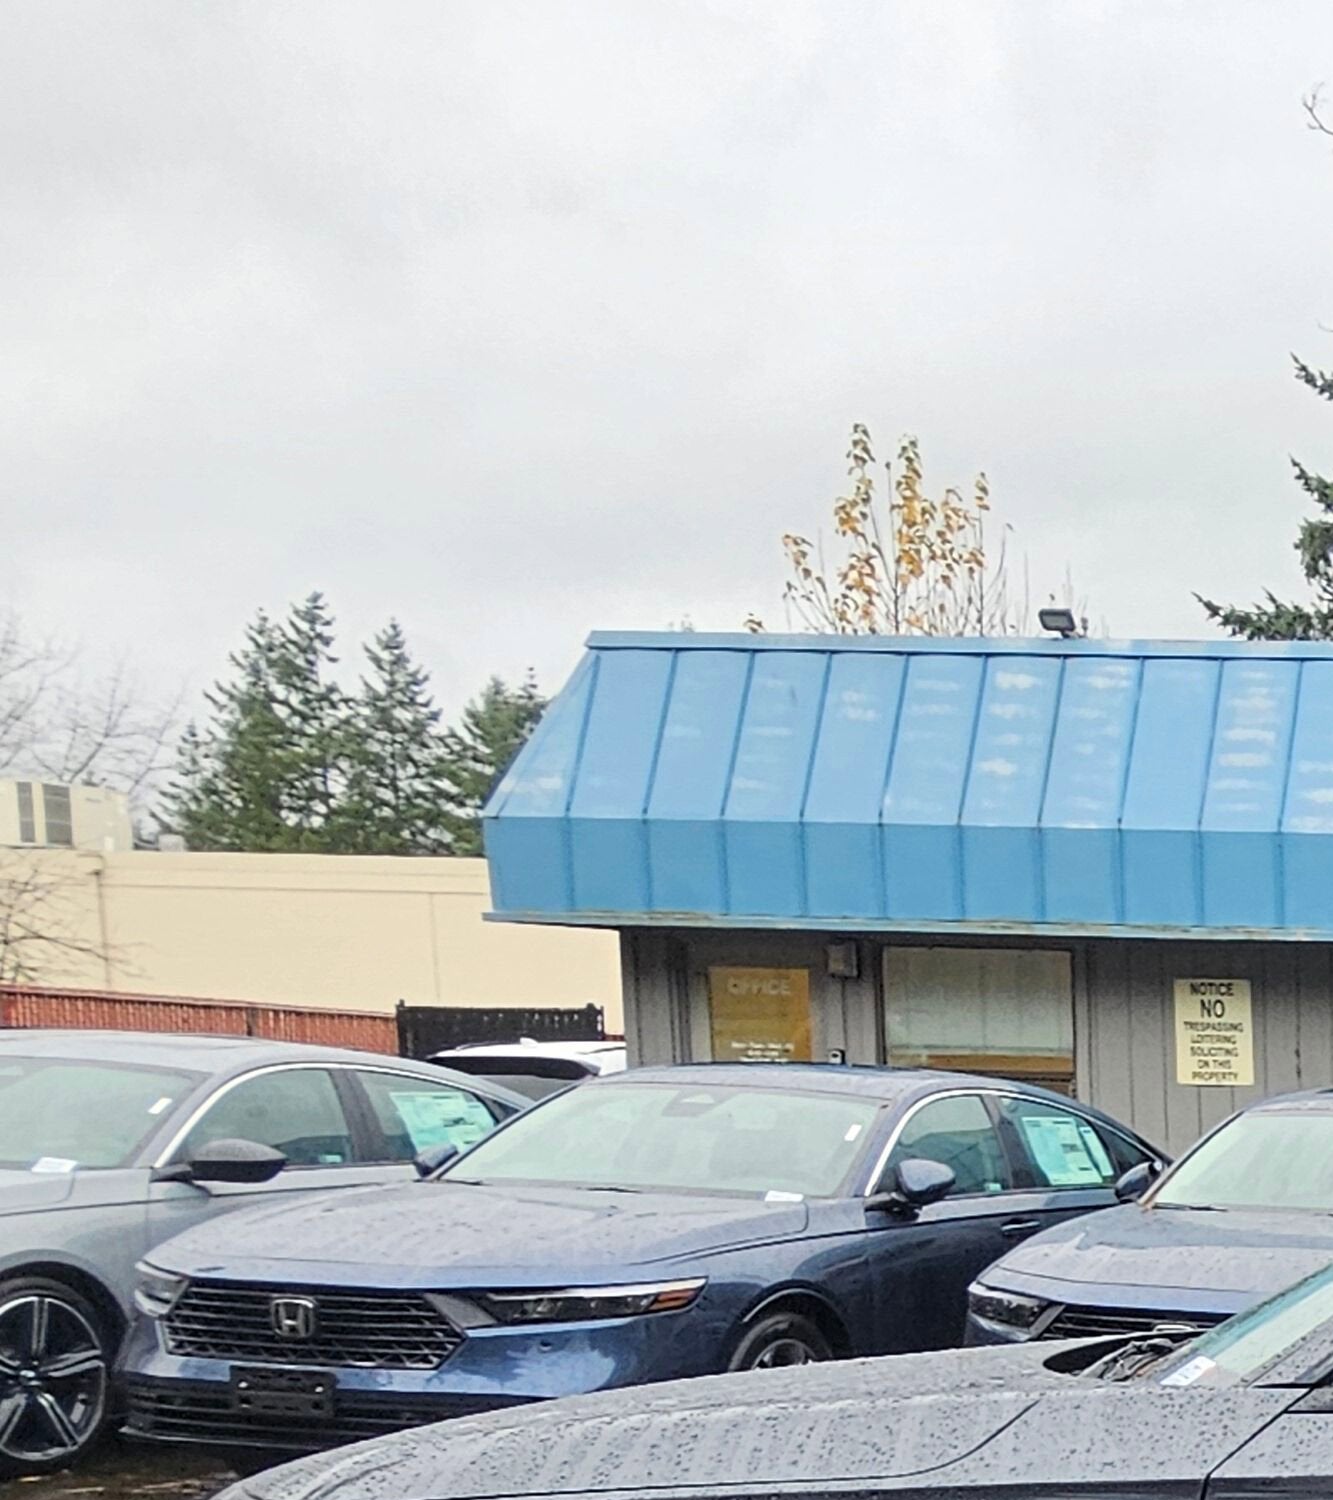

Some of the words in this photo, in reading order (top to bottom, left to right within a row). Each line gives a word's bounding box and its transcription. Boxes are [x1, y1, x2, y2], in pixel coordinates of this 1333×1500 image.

[1190, 982, 1234, 996] NOTICE
[1200, 999, 1225, 1018] NO
[1183, 1021, 1243, 1033] TRESPASSING
[1190, 1033, 1236, 1045] LOITERING
[1190, 1046, 1238, 1057] SOLICITING
[1198, 1059, 1209, 1069] ON
[1212, 1060, 1231, 1069] THIS
[1191, 1071, 1238, 1082] PROPERTY
